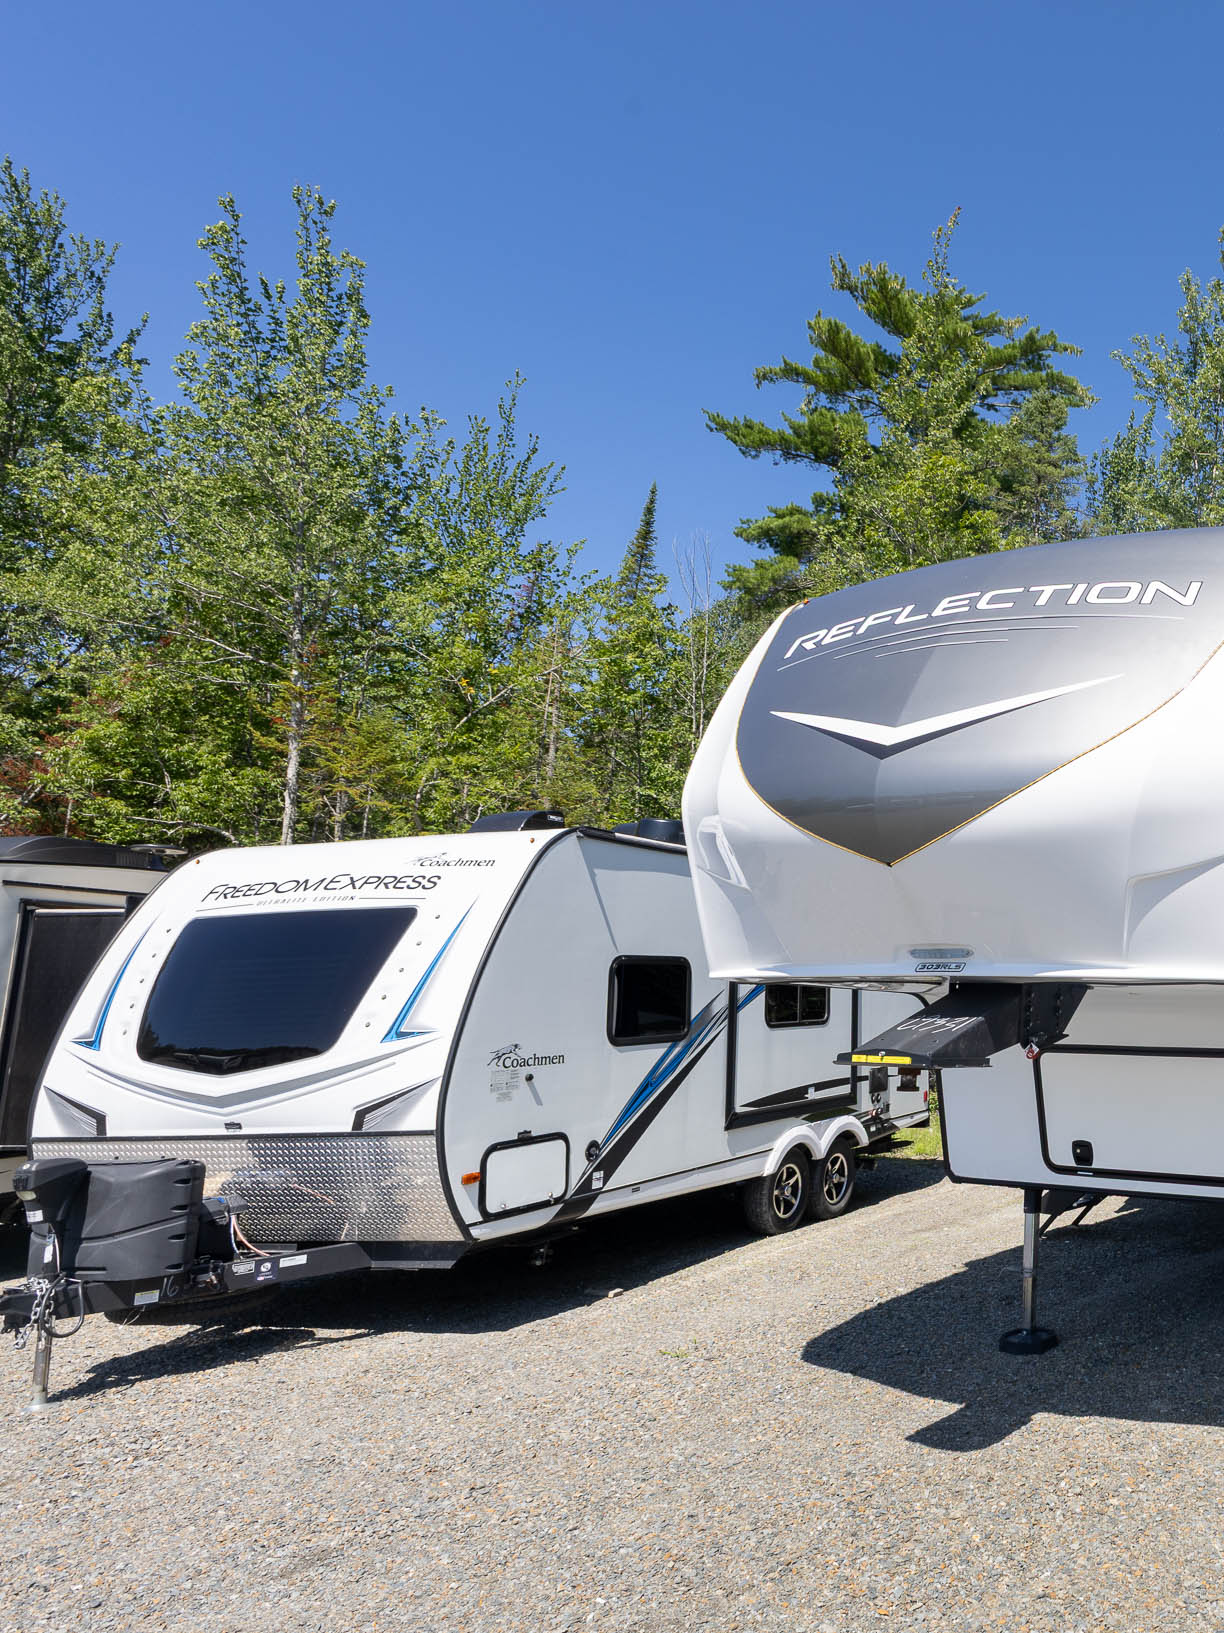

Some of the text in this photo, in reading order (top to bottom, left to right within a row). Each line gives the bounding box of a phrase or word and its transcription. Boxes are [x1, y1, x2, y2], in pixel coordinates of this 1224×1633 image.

[783, 580, 1203, 659] REFLECTION
[419, 857, 496, 867] Coachmen
[502, 1053, 566, 1069] Coachmen
